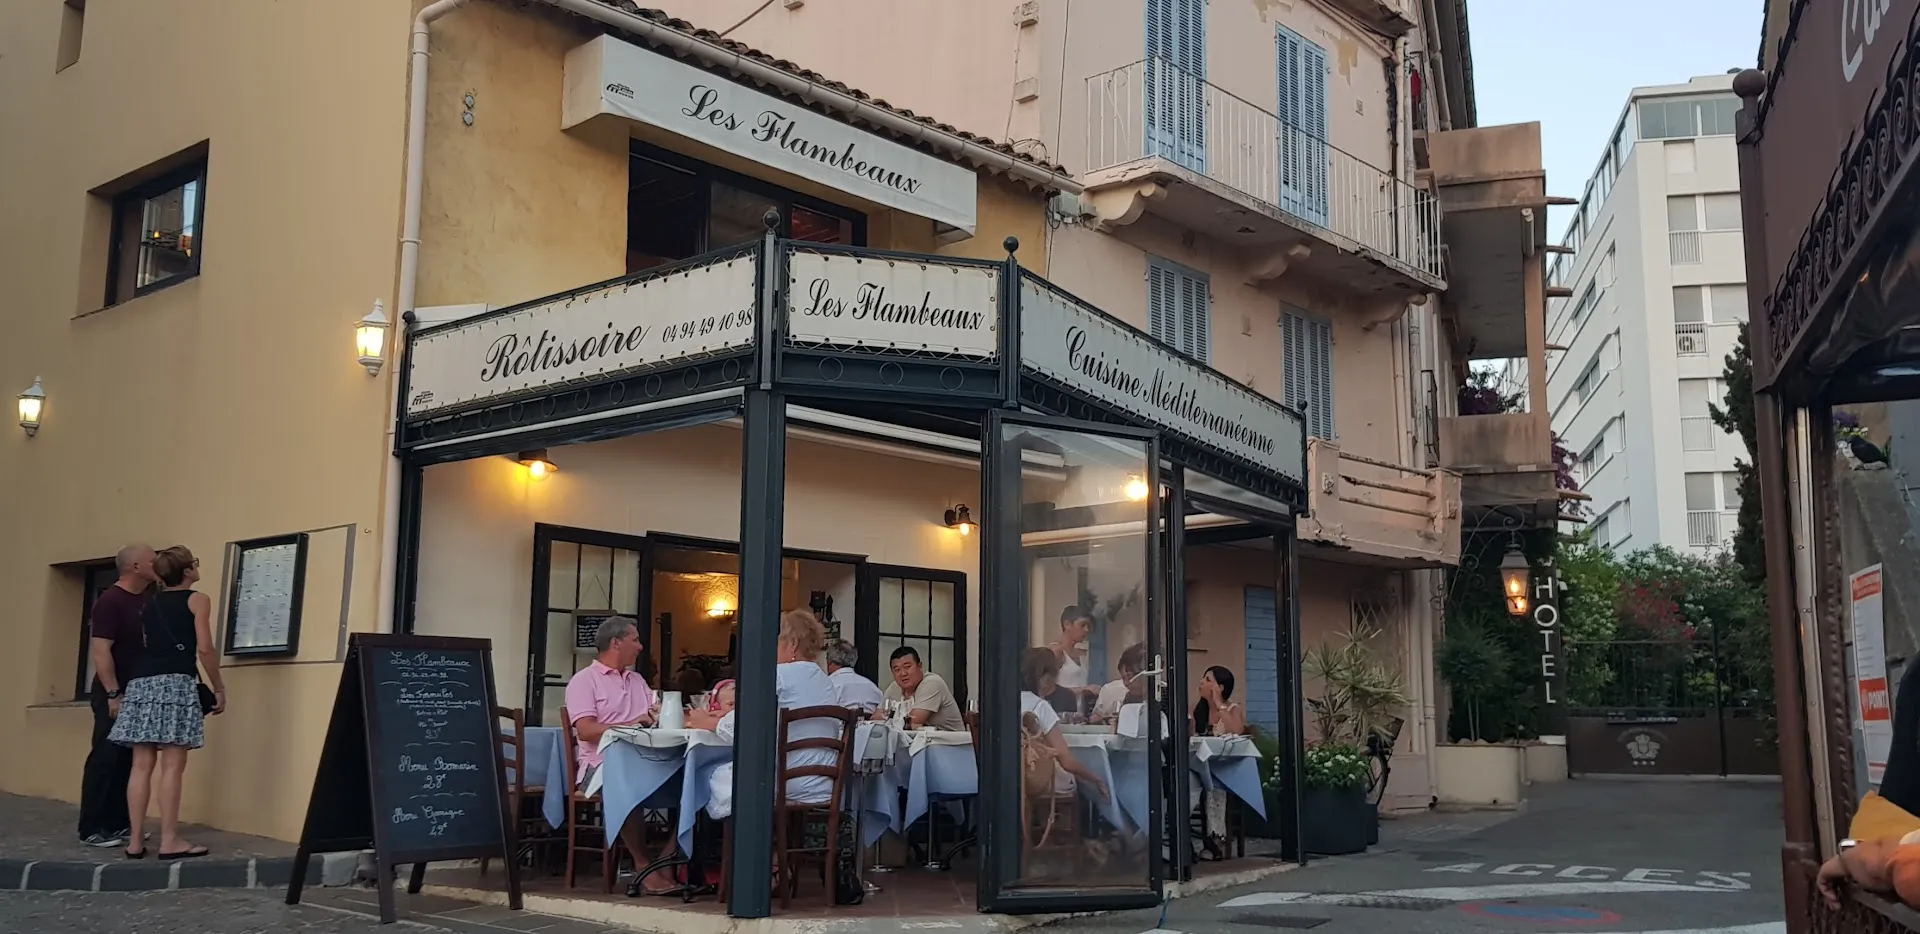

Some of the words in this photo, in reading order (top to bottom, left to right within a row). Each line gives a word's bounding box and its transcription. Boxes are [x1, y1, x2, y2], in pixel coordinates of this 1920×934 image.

[682, 84, 745, 130] Les
[751, 110, 922, 194] Flambeaux
[804, 278, 849, 317] Les
[852, 282, 986, 330] Flambeaux
[481, 321, 652, 383] Rôtissoire
[662, 325, 678, 343] 04
[679, 321, 696, 339] 94
[698, 316, 715, 336] 49
[718, 312, 734, 331] 10
[736, 307, 753, 328] 98
[1066, 326, 1144, 398] Cuisine
[1143, 367, 1276, 456] Méditerranéenne
[390, 651, 411, 666] Les
[1534, 575, 1558, 704] HOTEL
[1422, 862, 1752, 890] ACCES
